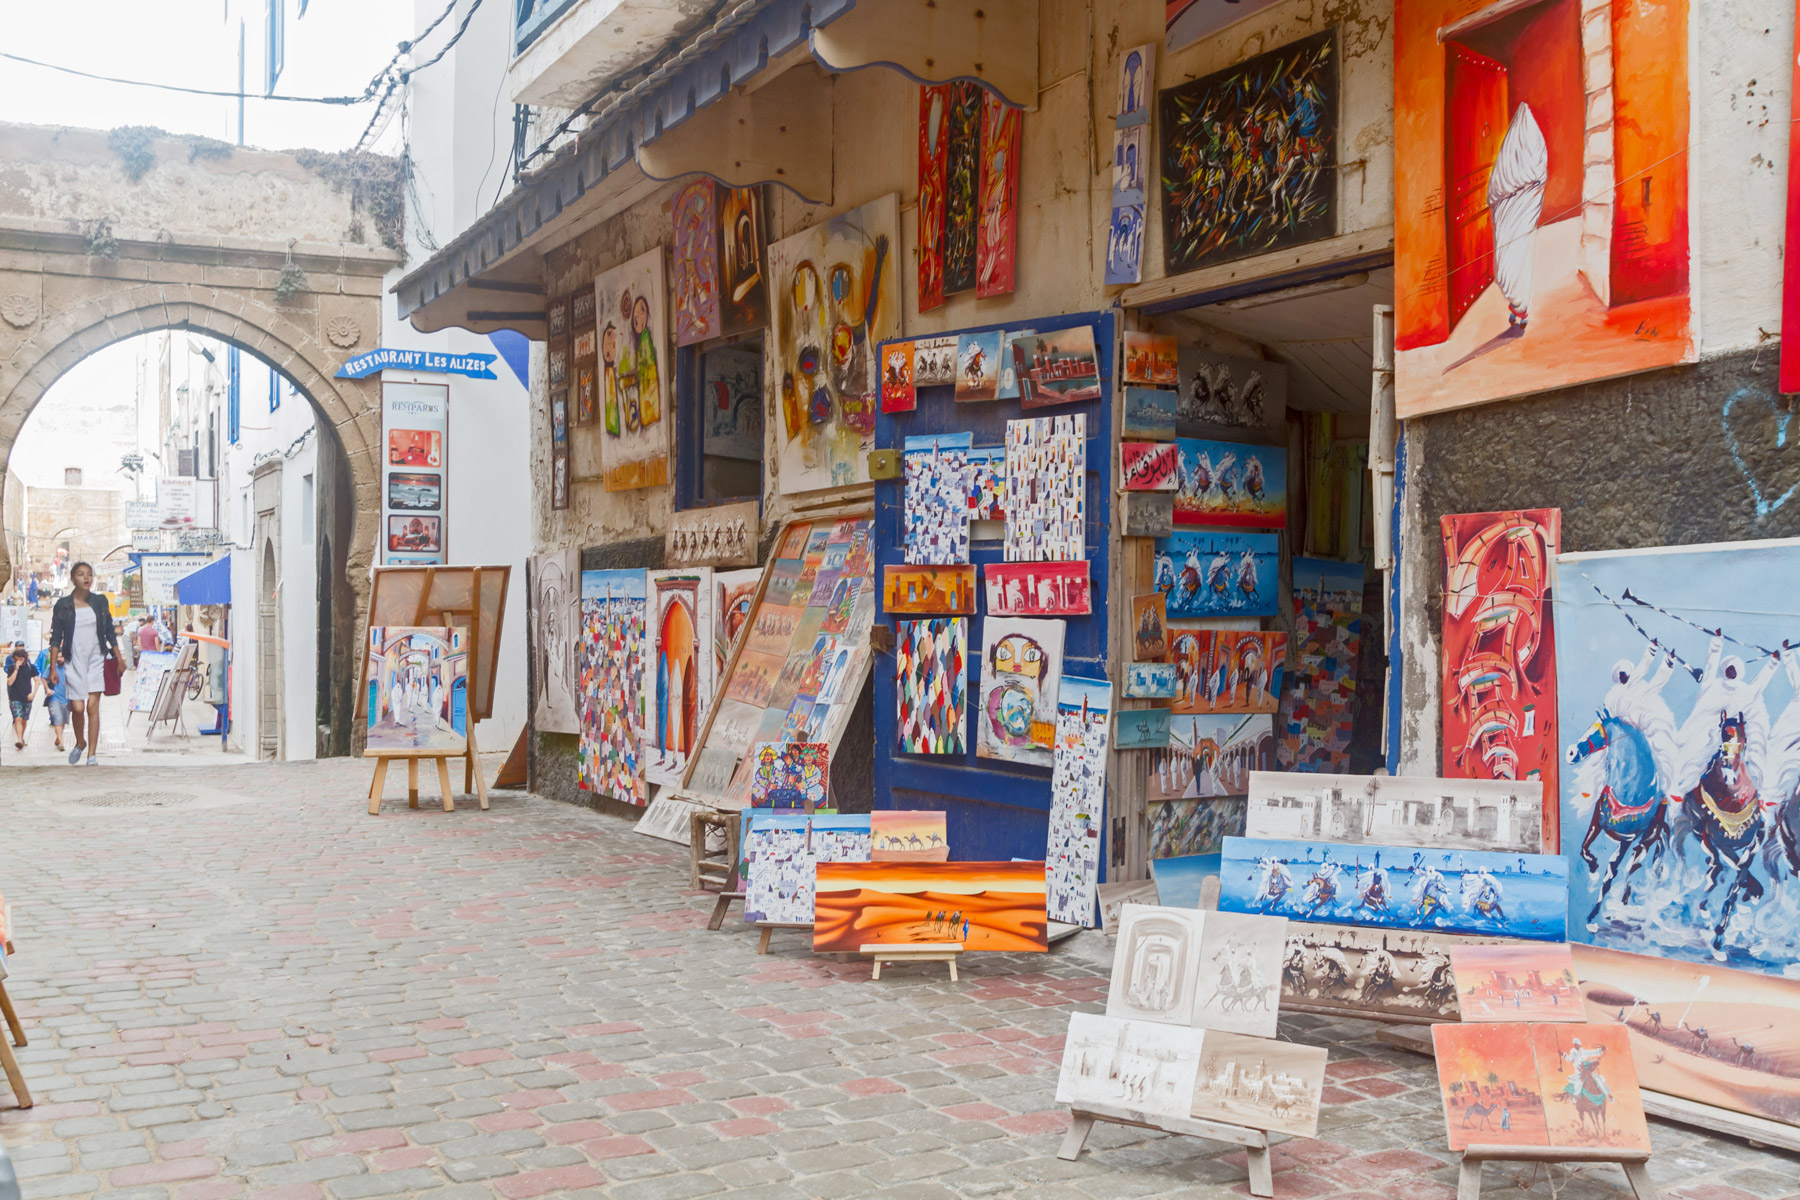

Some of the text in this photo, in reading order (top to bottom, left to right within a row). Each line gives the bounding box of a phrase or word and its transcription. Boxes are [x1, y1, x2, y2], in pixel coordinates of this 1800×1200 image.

[345, 351, 486, 376] RESTAURANT LES ALIZES
